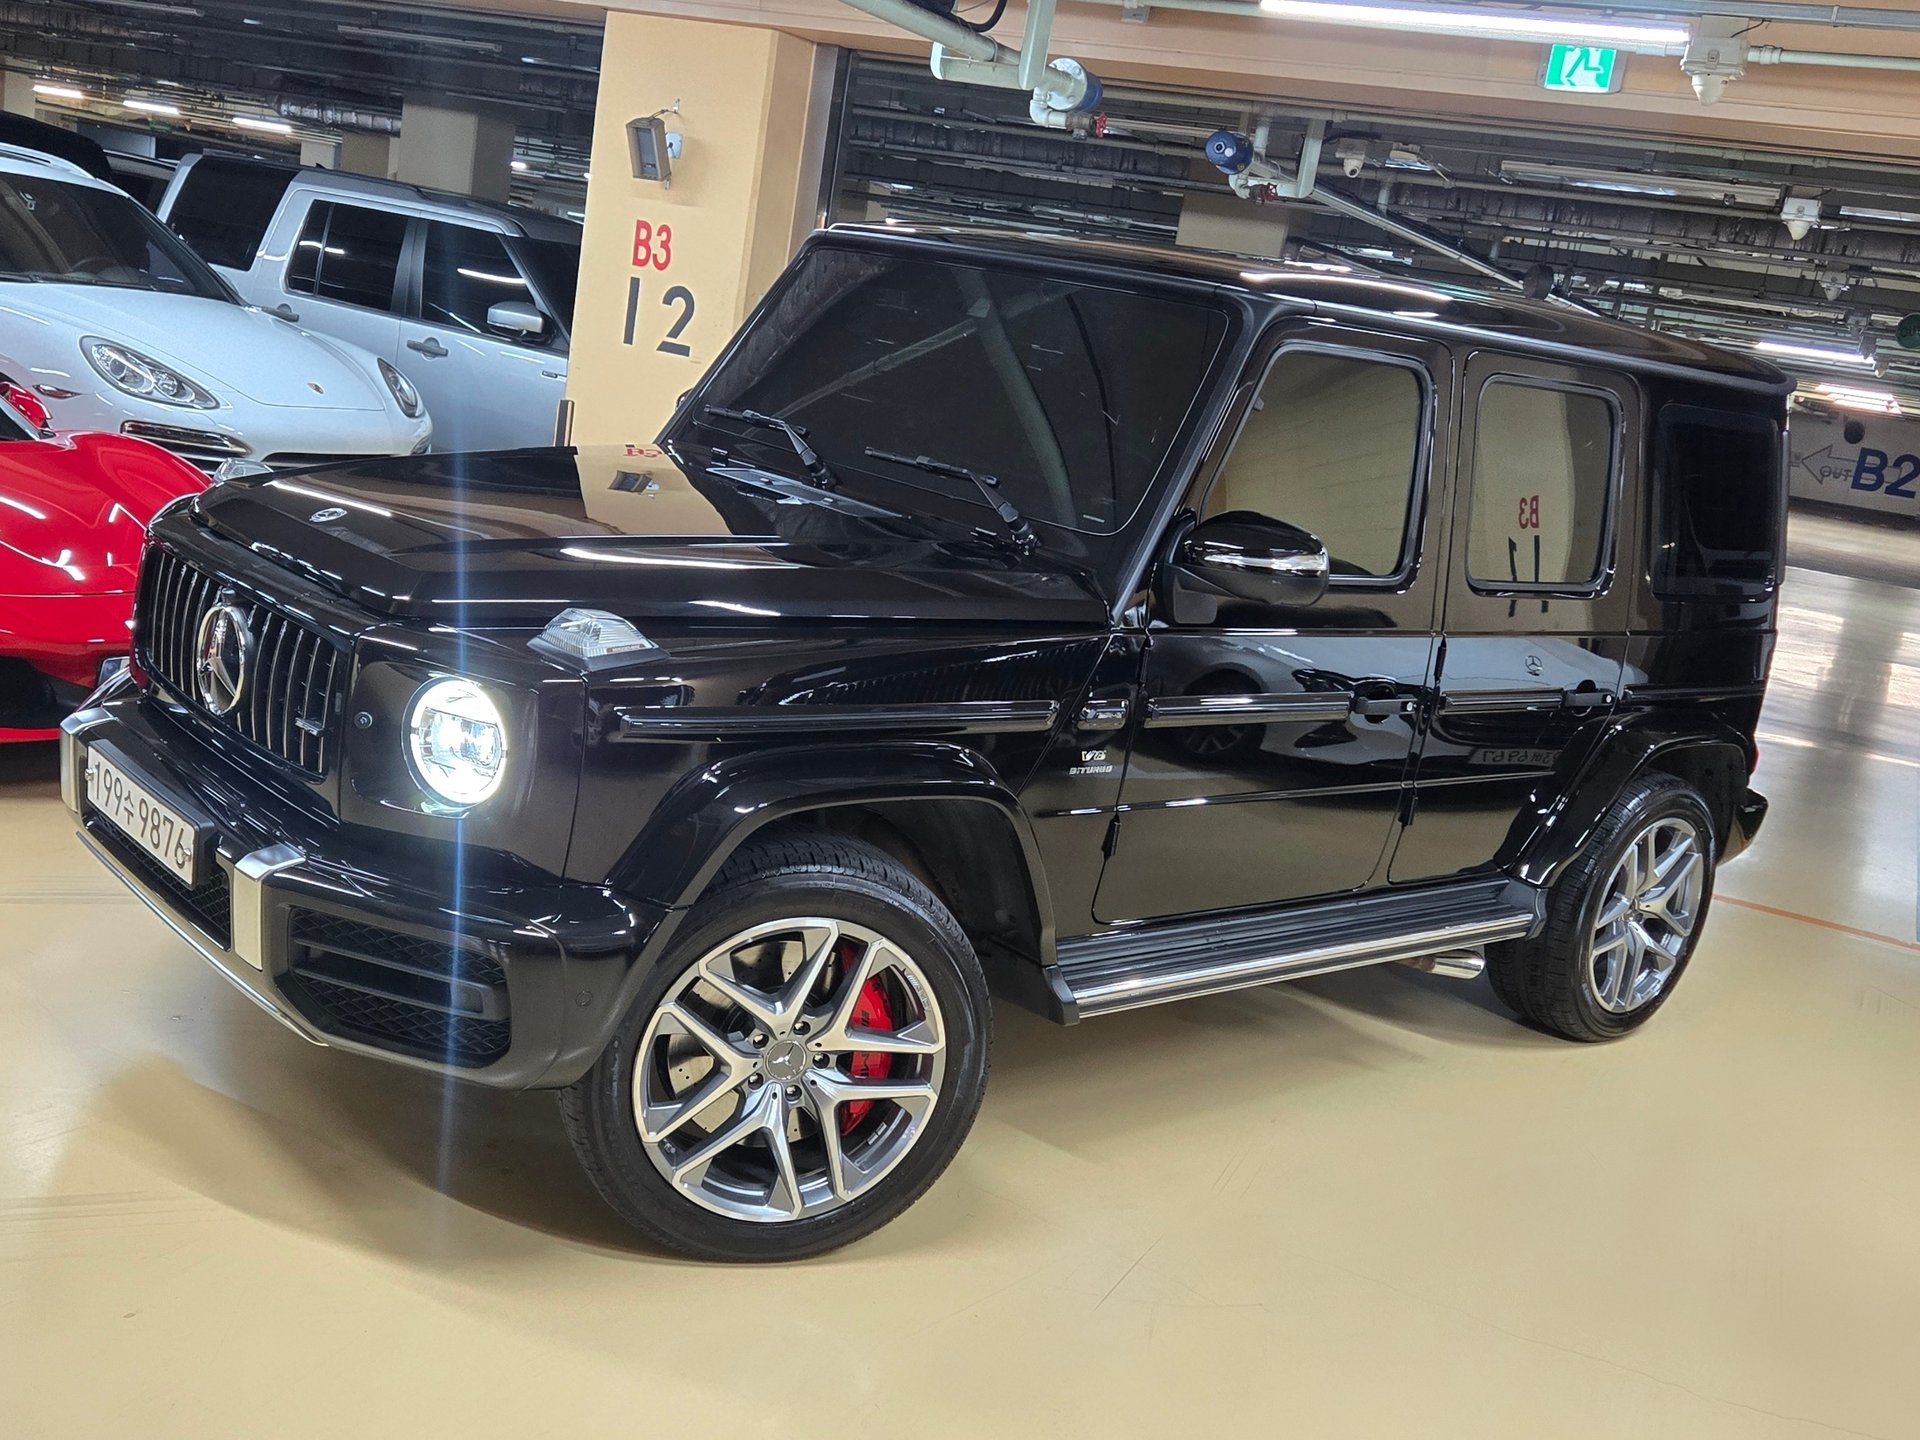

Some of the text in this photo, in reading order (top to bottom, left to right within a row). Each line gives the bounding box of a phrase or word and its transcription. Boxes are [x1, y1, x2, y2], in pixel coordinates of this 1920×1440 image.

[632, 219, 672, 271] B3
[623, 276, 695, 358] 12
[1820, 465, 1852, 482] OUT
[1851, 447, 1920, 499] B2
[1081, 750, 1107, 761] V8
